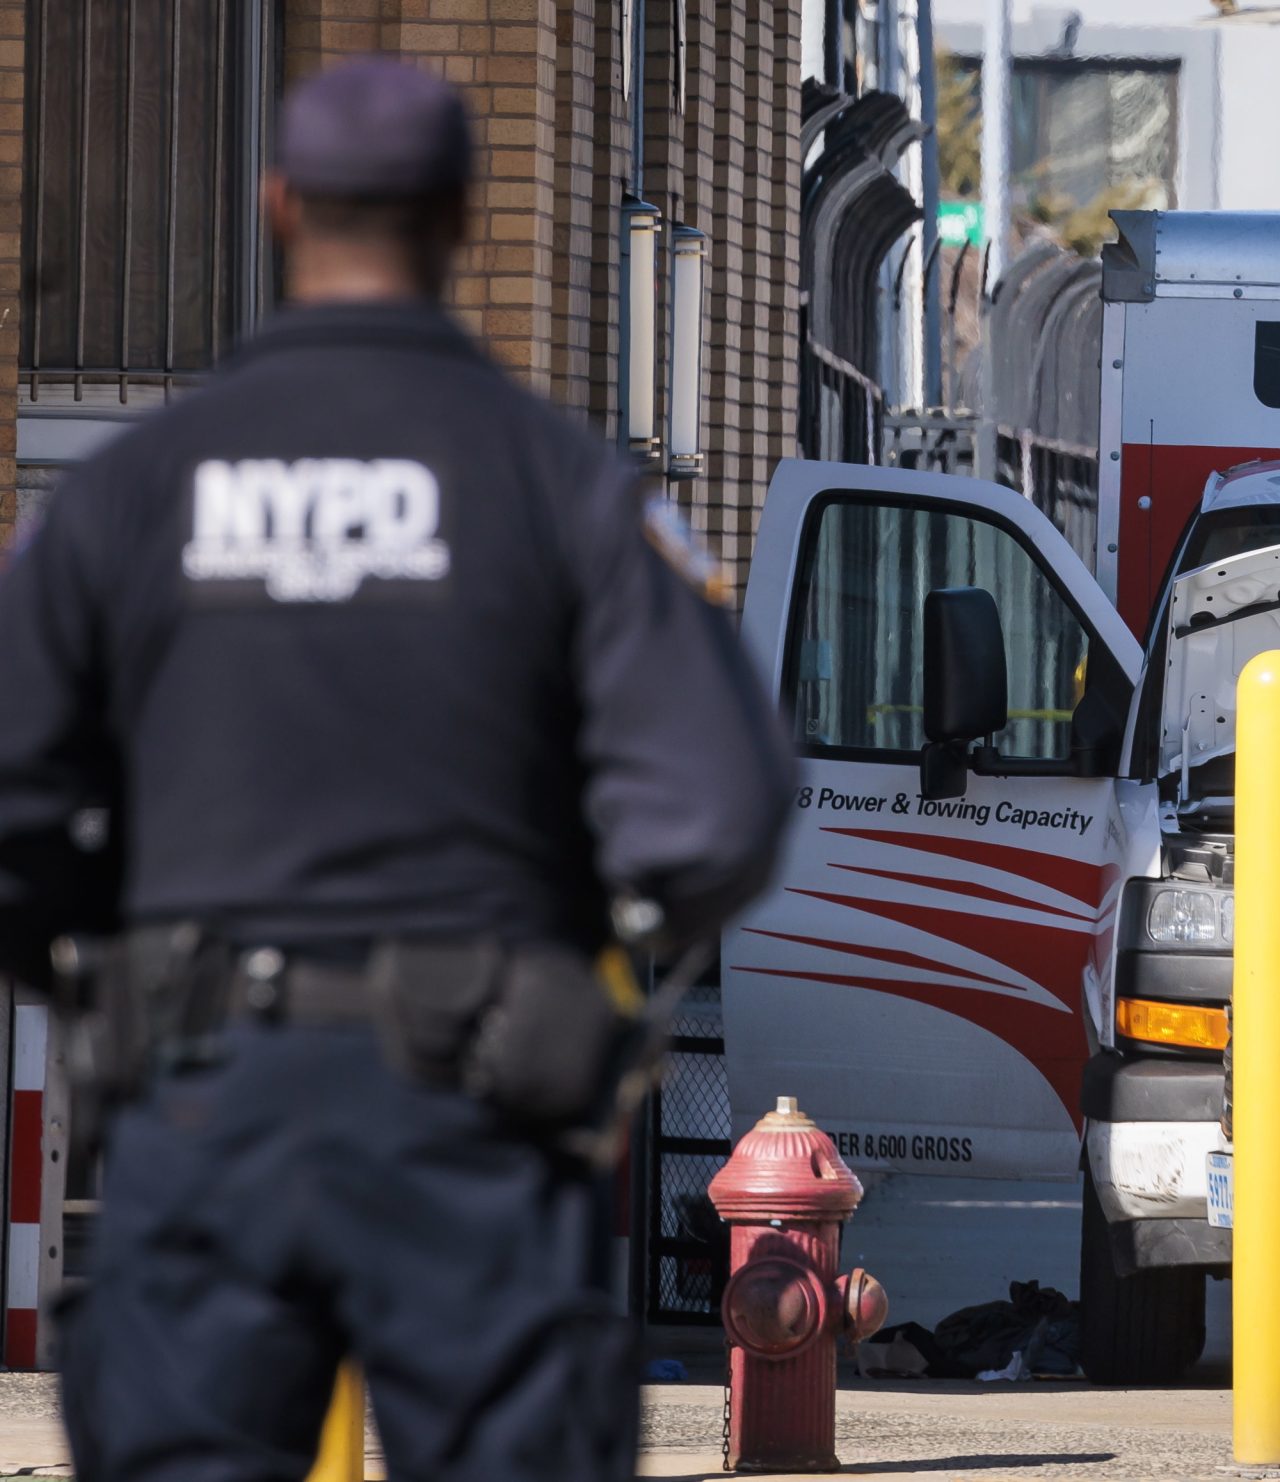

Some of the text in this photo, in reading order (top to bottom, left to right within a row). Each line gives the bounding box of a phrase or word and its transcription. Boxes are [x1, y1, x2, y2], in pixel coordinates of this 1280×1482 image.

[194, 457, 440, 546] NYPD
[817, 787, 888, 813] Power
[890, 792, 911, 815] &
[915, 793, 992, 826] Towing
[994, 800, 1094, 836] Capacity
[864, 1133, 907, 1161] 8,600
[911, 1135, 973, 1163] GROSS
